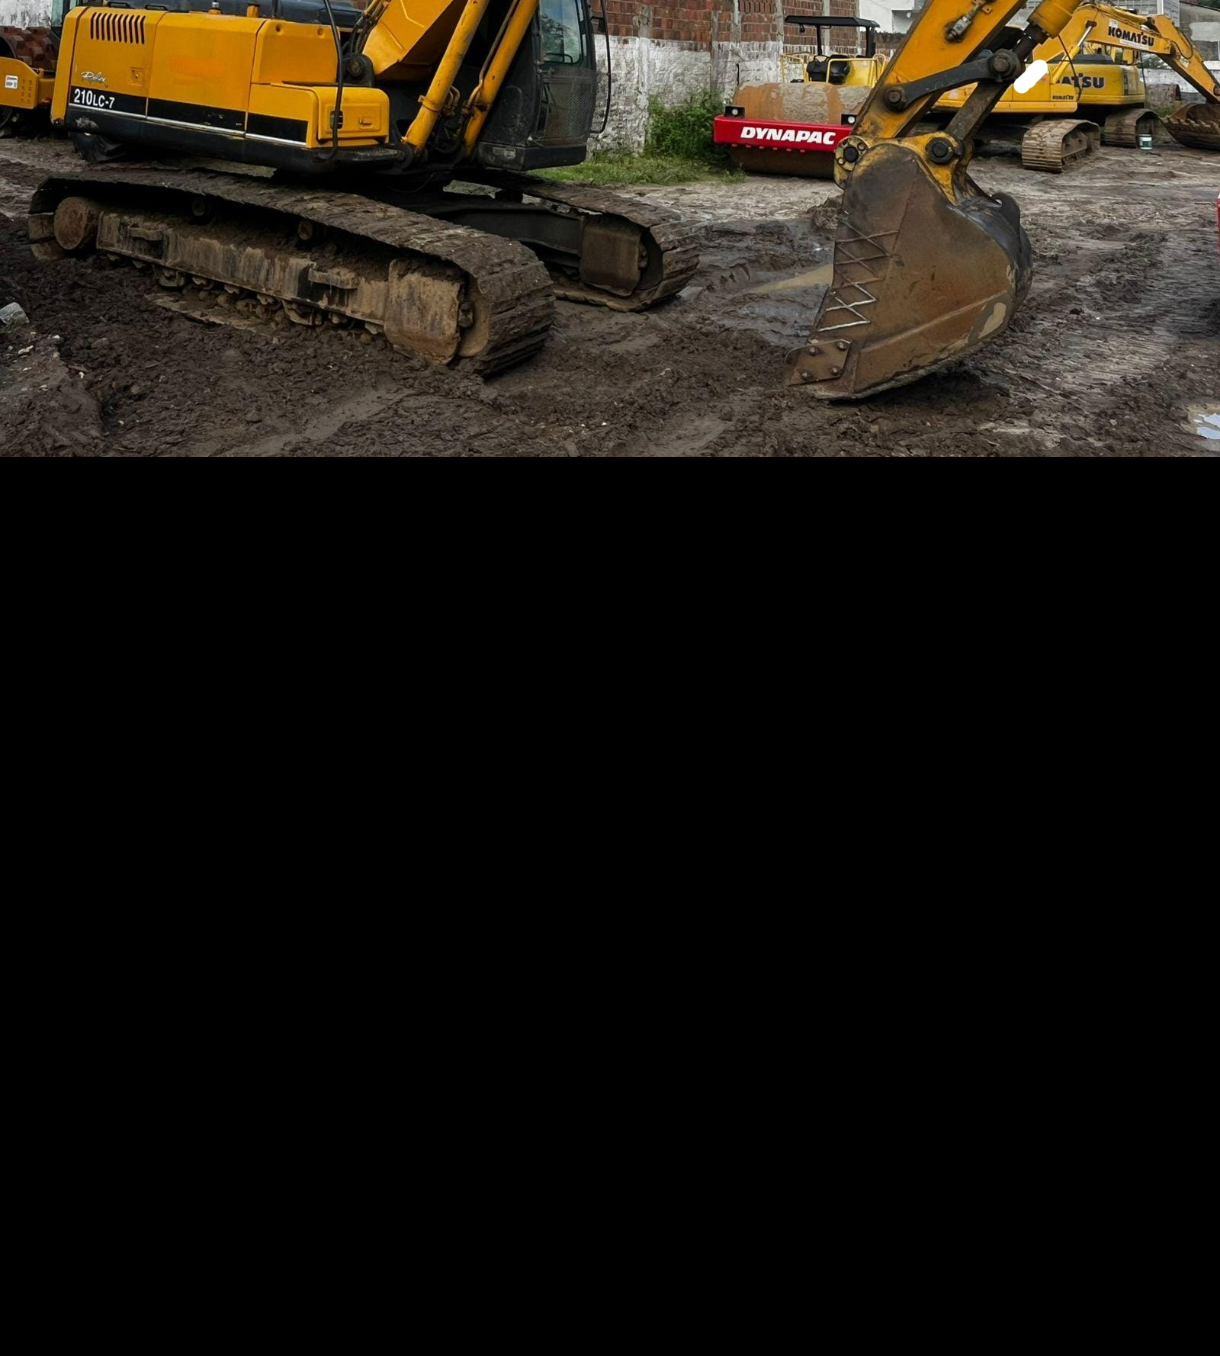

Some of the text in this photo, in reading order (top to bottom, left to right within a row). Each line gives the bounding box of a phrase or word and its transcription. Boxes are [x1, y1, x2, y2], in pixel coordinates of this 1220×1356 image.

[1108, 26, 1154, 46] KOMATSU
[1057, 73, 1104, 88] ATSU
[74, 88, 115, 109] 210LC-7
[740, 126, 836, 145] DYNAPAC
